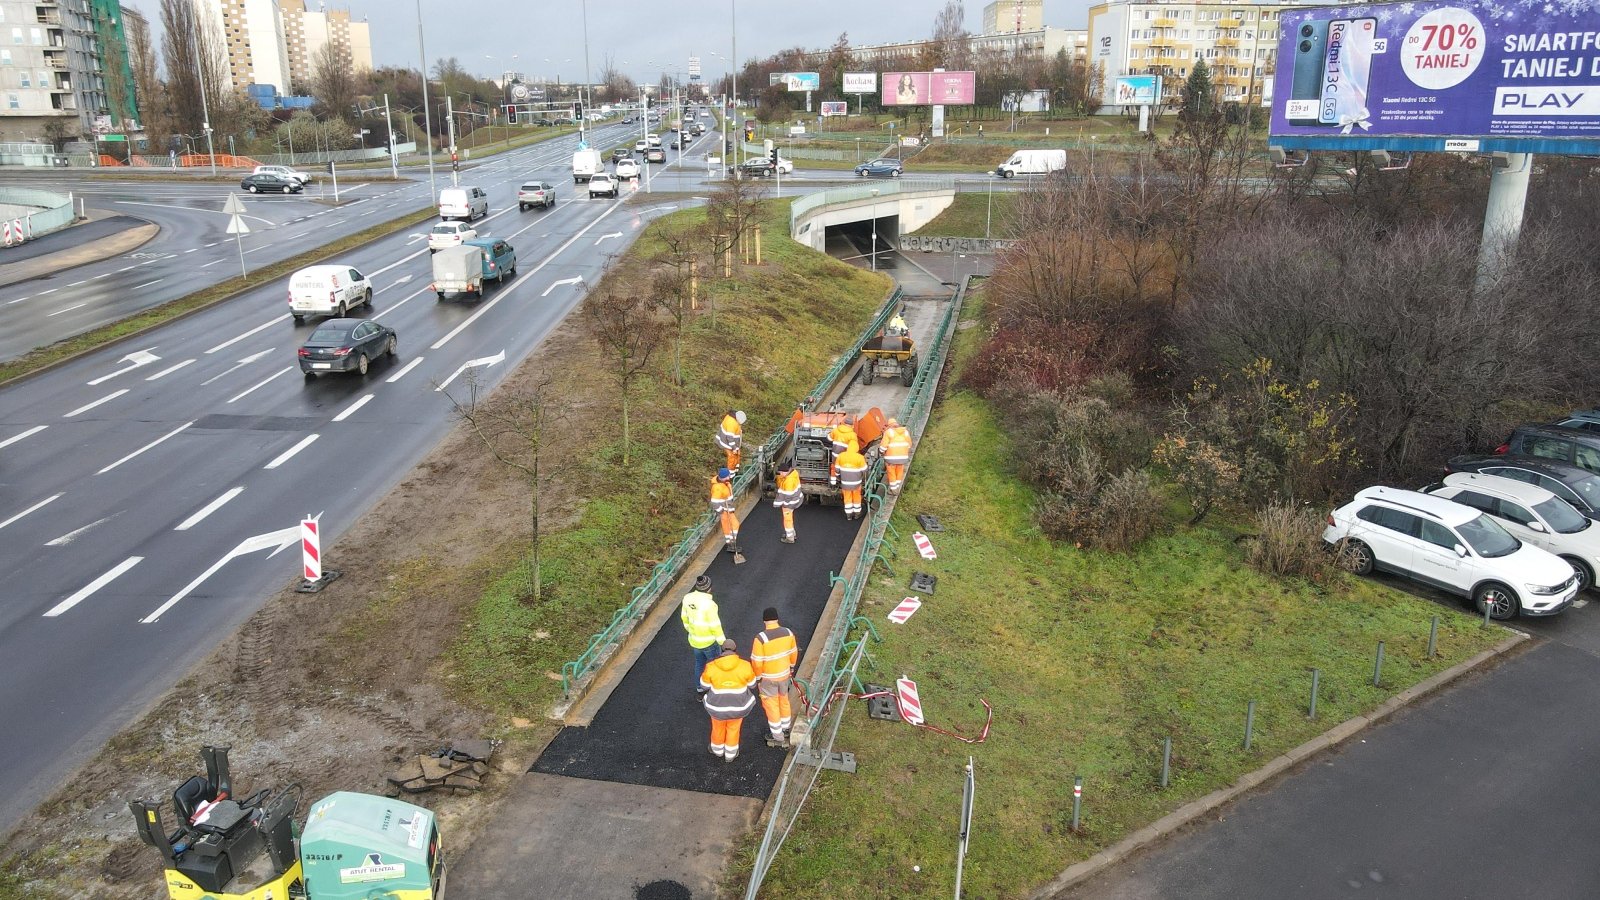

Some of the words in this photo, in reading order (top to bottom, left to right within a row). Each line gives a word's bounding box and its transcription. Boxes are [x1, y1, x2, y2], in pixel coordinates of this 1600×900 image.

[1100, 36, 1111, 48] 12
[1330, 23, 1345, 64] Redmi
[1408, 36, 1420, 44] DO
[1422, 24, 1477, 51] 70%
[1373, 41, 1385, 51] 5G
[1414, 54, 1469, 69] TANIEJ
[1501, 57, 1583, 78] TANIEJ
[1325, 68, 1339, 93] 13C
[1501, 93, 1585, 108] PLAY
[1325, 102, 1335, 117] 5G
